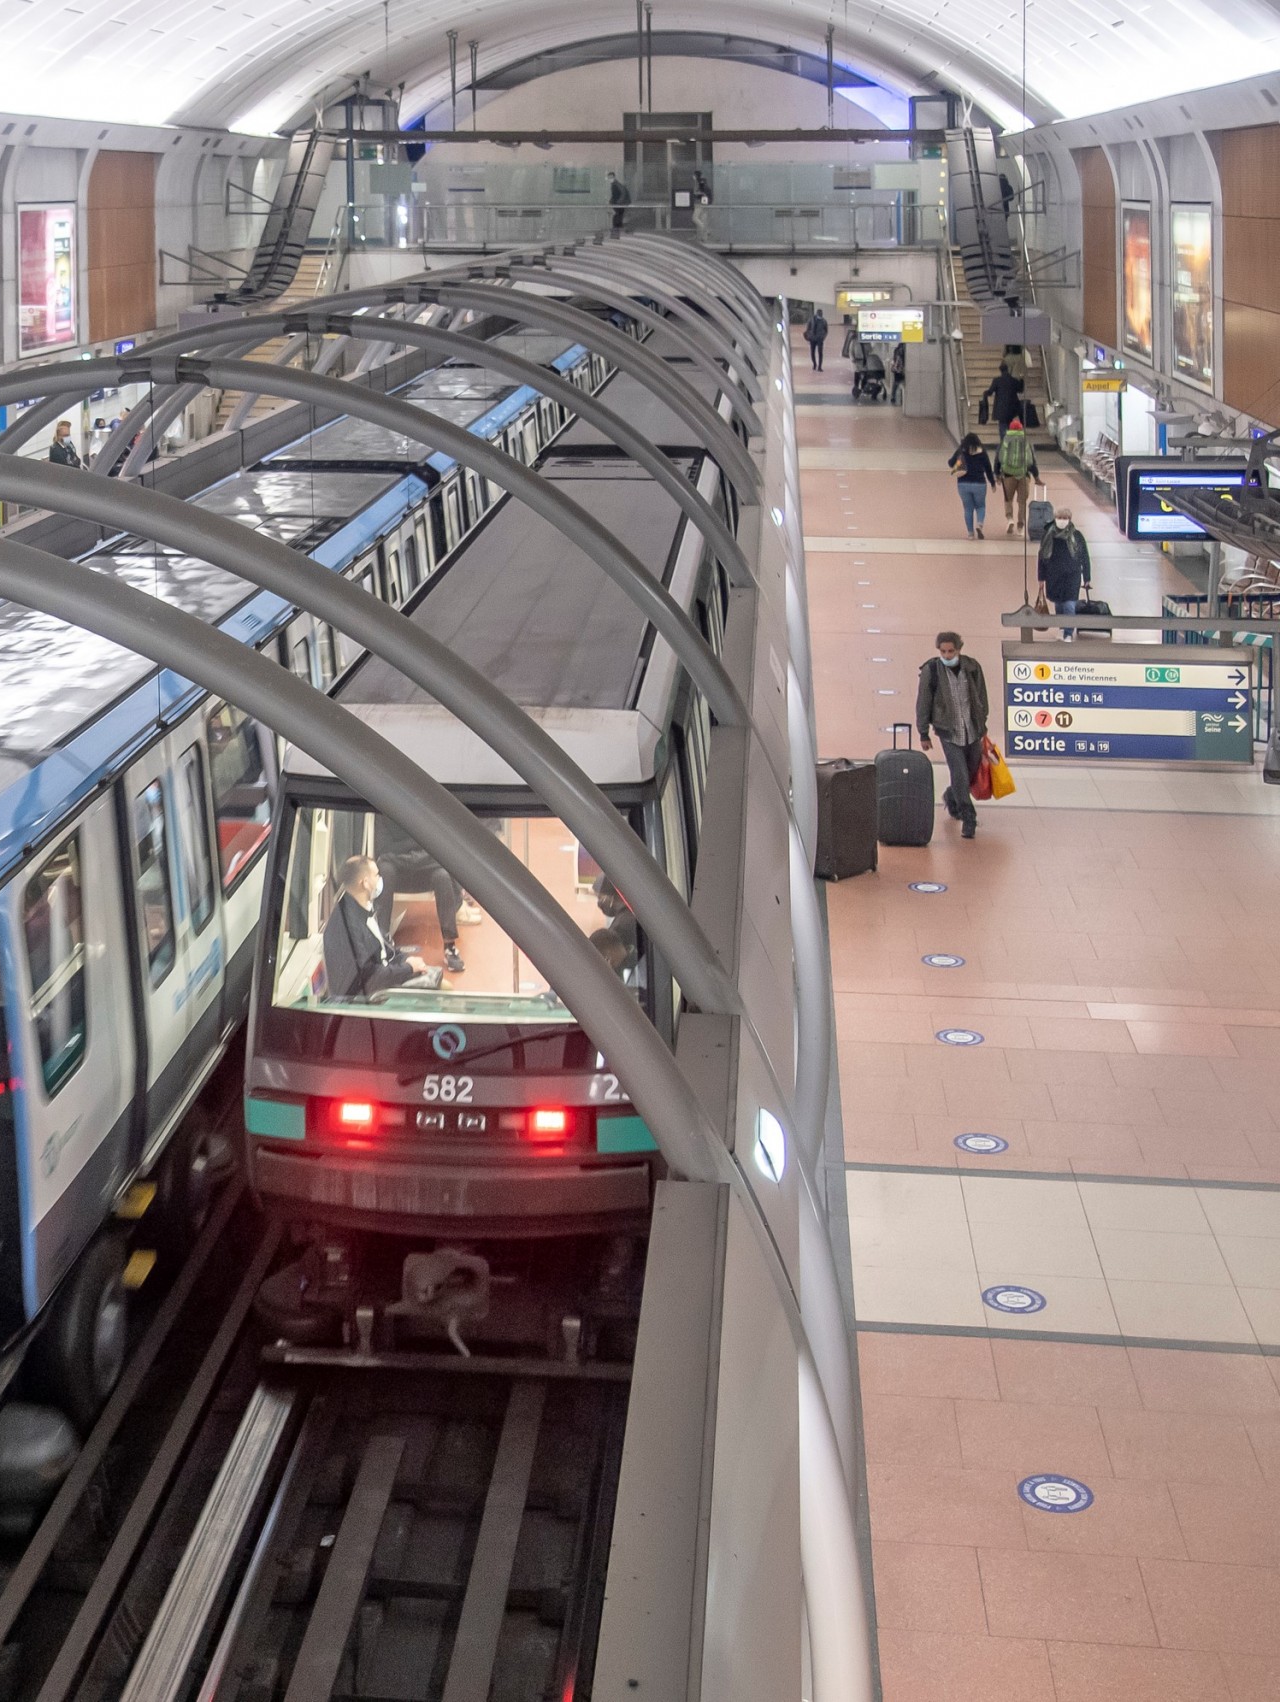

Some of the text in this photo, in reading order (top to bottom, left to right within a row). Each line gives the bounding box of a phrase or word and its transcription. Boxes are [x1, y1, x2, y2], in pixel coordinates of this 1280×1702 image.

[1086, 382, 1110, 391] Appel
[1013, 688, 1103, 703] Sortie 10 à 14
[1014, 735, 1109, 751] Sortie 15 à 19
[422, 1074, 474, 1104] 582
